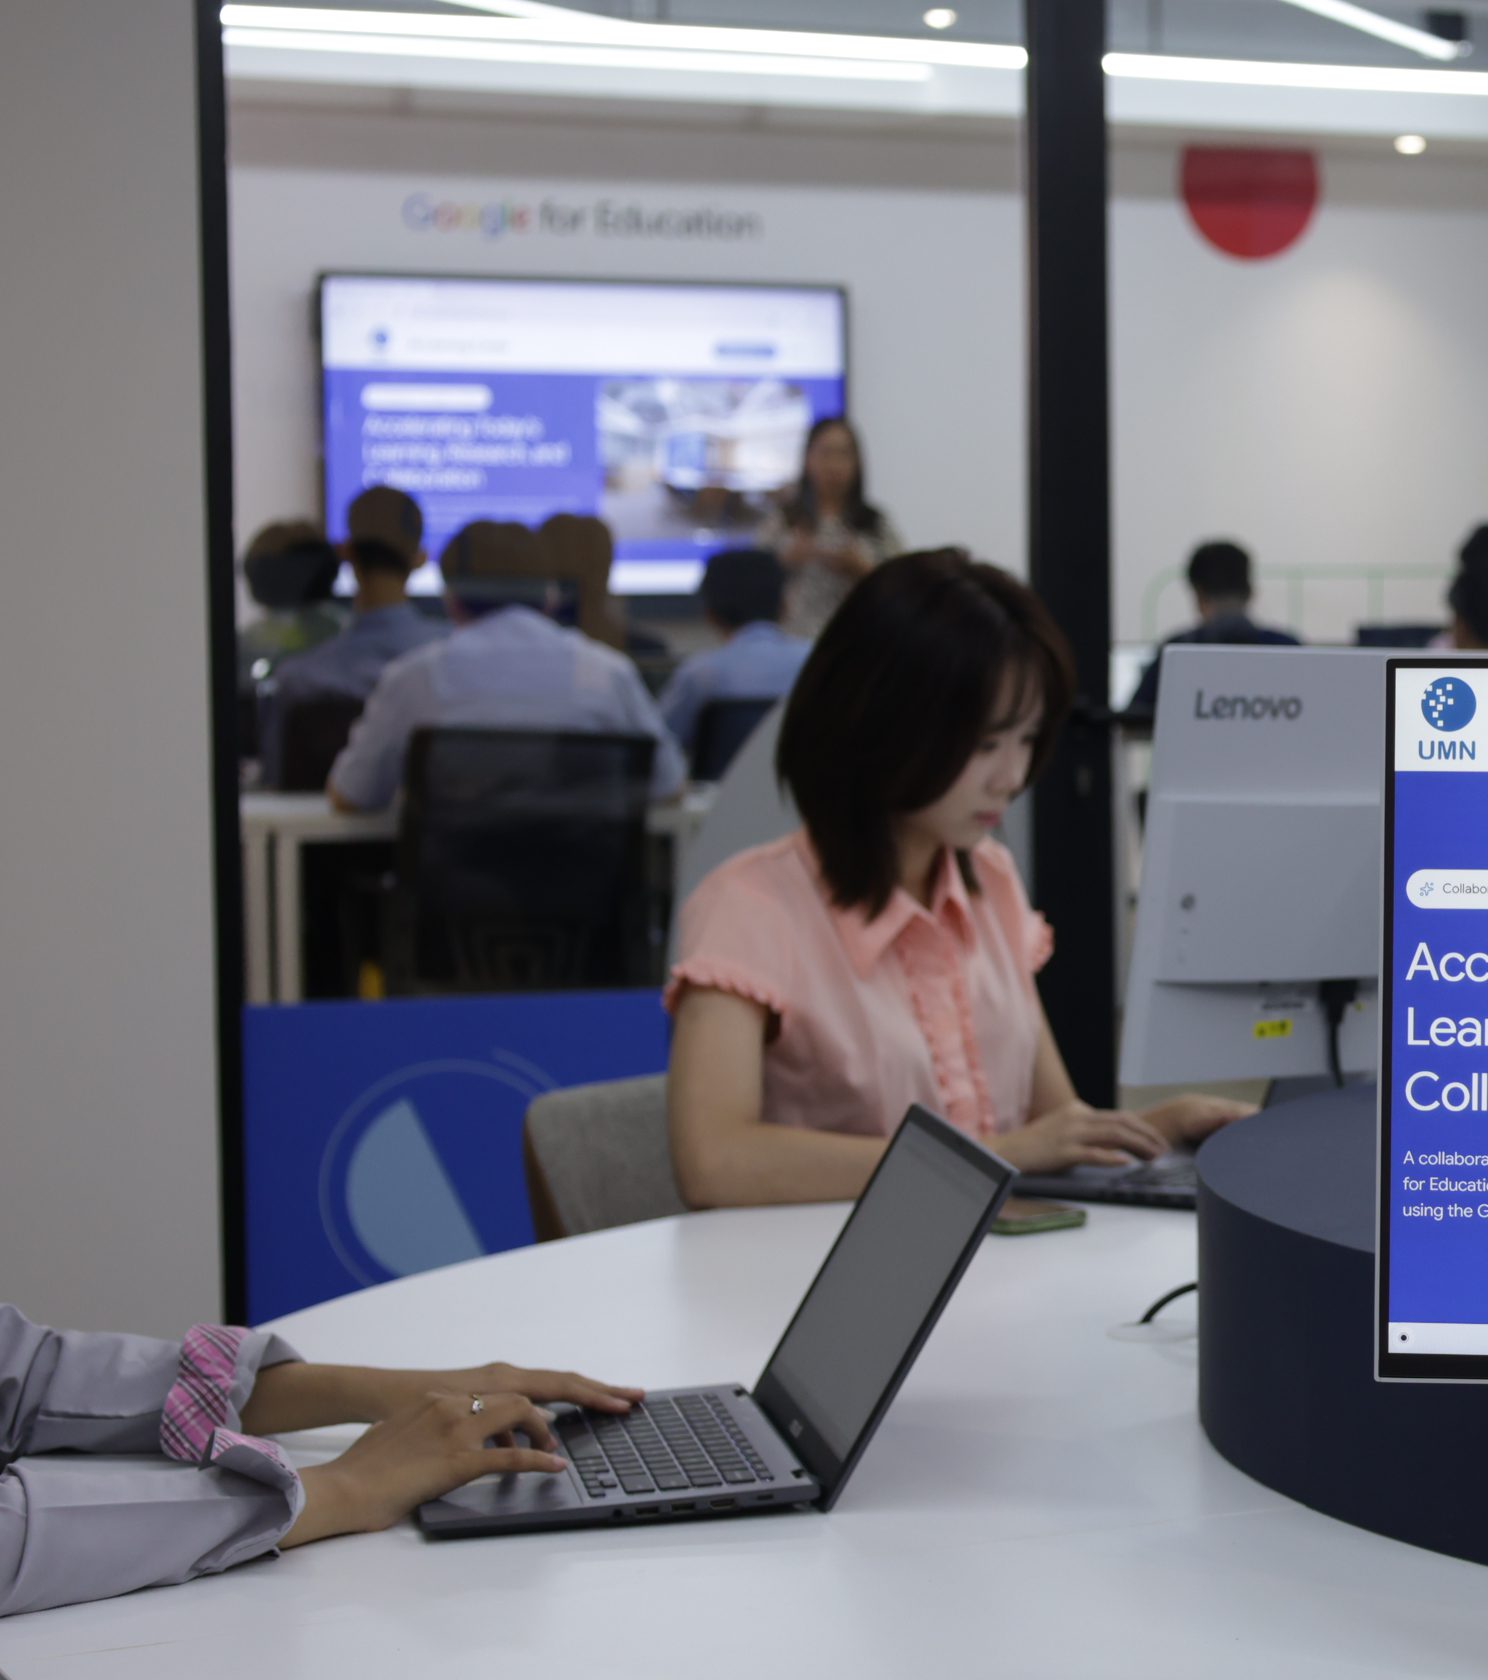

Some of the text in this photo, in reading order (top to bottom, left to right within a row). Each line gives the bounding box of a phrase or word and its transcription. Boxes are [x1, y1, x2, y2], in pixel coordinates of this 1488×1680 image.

[401, 191, 764, 243] Google for Education
[1194, 688, 1302, 721] Lenovo
[1418, 740, 1476, 761] UMN
[1403, 1150, 1415, 1165] A
[1403, 1177, 1425, 1191] for
[1403, 1203, 1443, 1221] using
[1448, 1203, 1473, 1218] the
